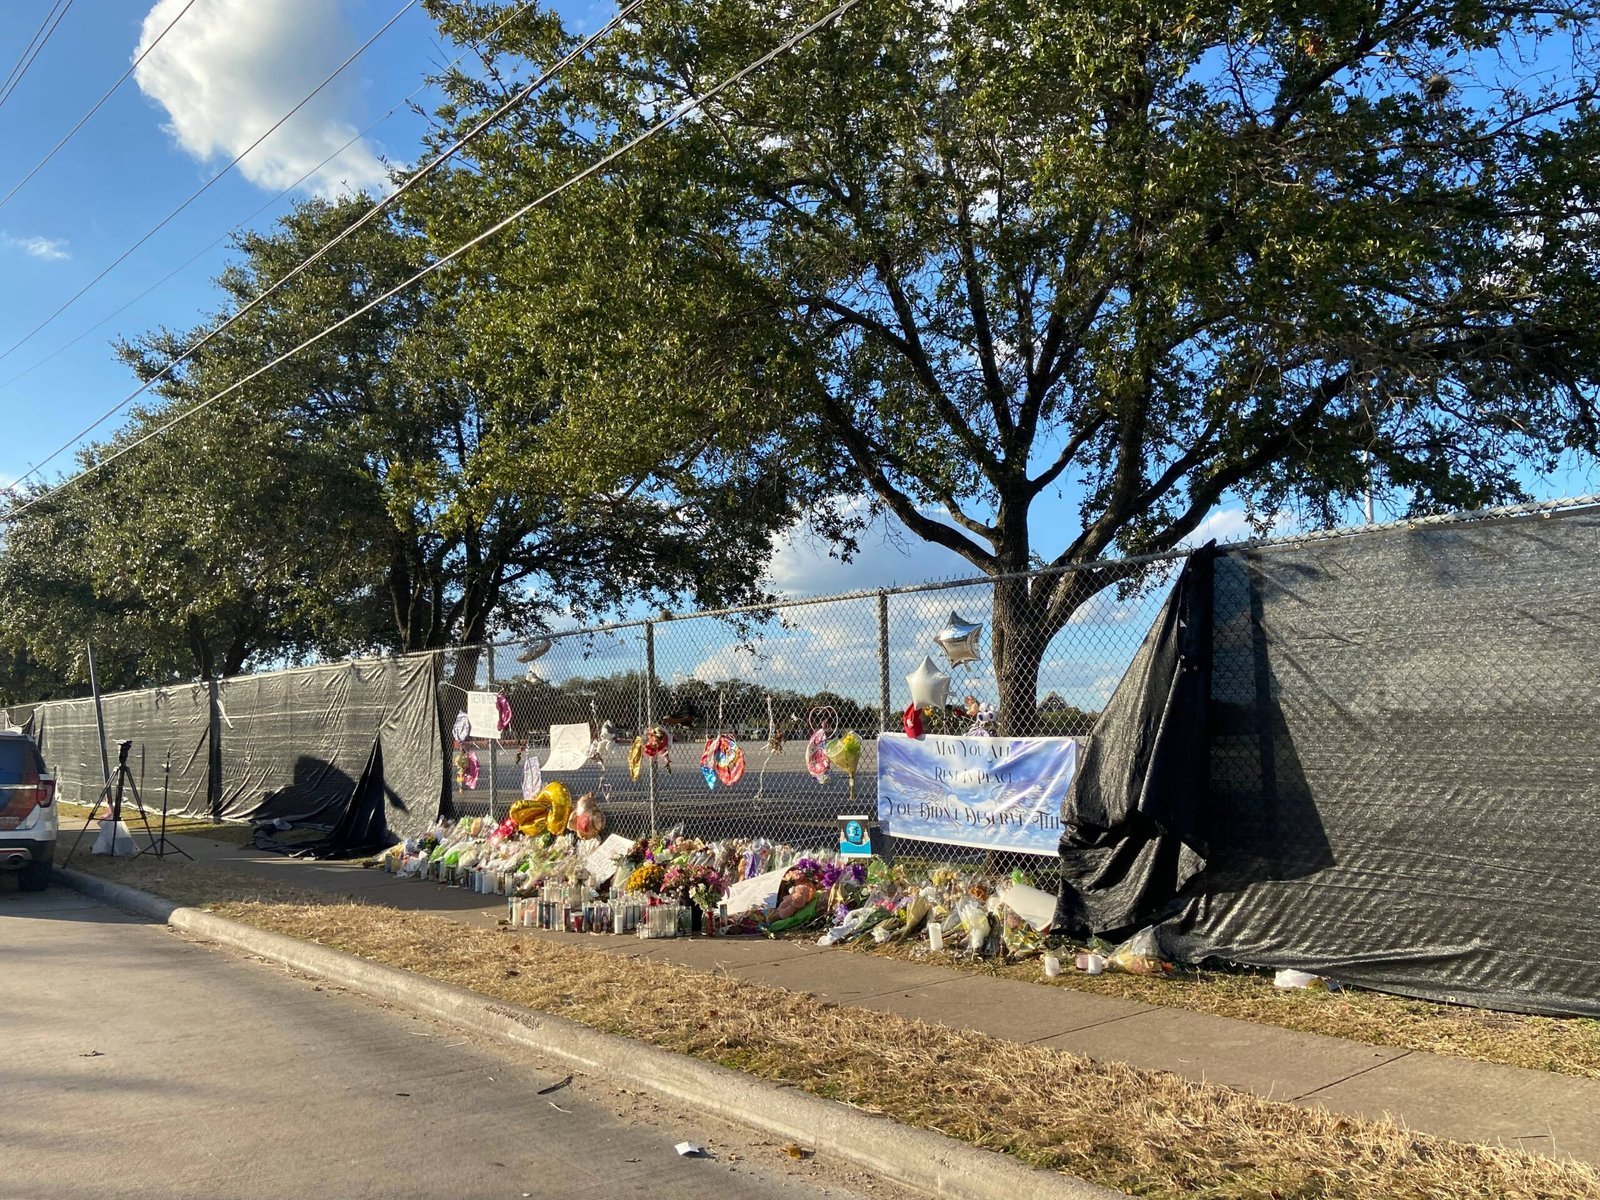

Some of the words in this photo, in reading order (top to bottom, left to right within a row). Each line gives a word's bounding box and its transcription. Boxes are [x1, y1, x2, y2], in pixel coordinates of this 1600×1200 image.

[935, 741, 957, 756] MAY
[958, 739, 983, 758] YOU
[986, 744, 1012, 763] ALL
[935, 766, 959, 784] REST
[962, 769, 974, 784] IN
[977, 769, 1015, 785] PEACE
[883, 795, 914, 816] YOU
[919, 803, 959, 823] DIDN'T
[964, 807, 1025, 829] DESERVE
